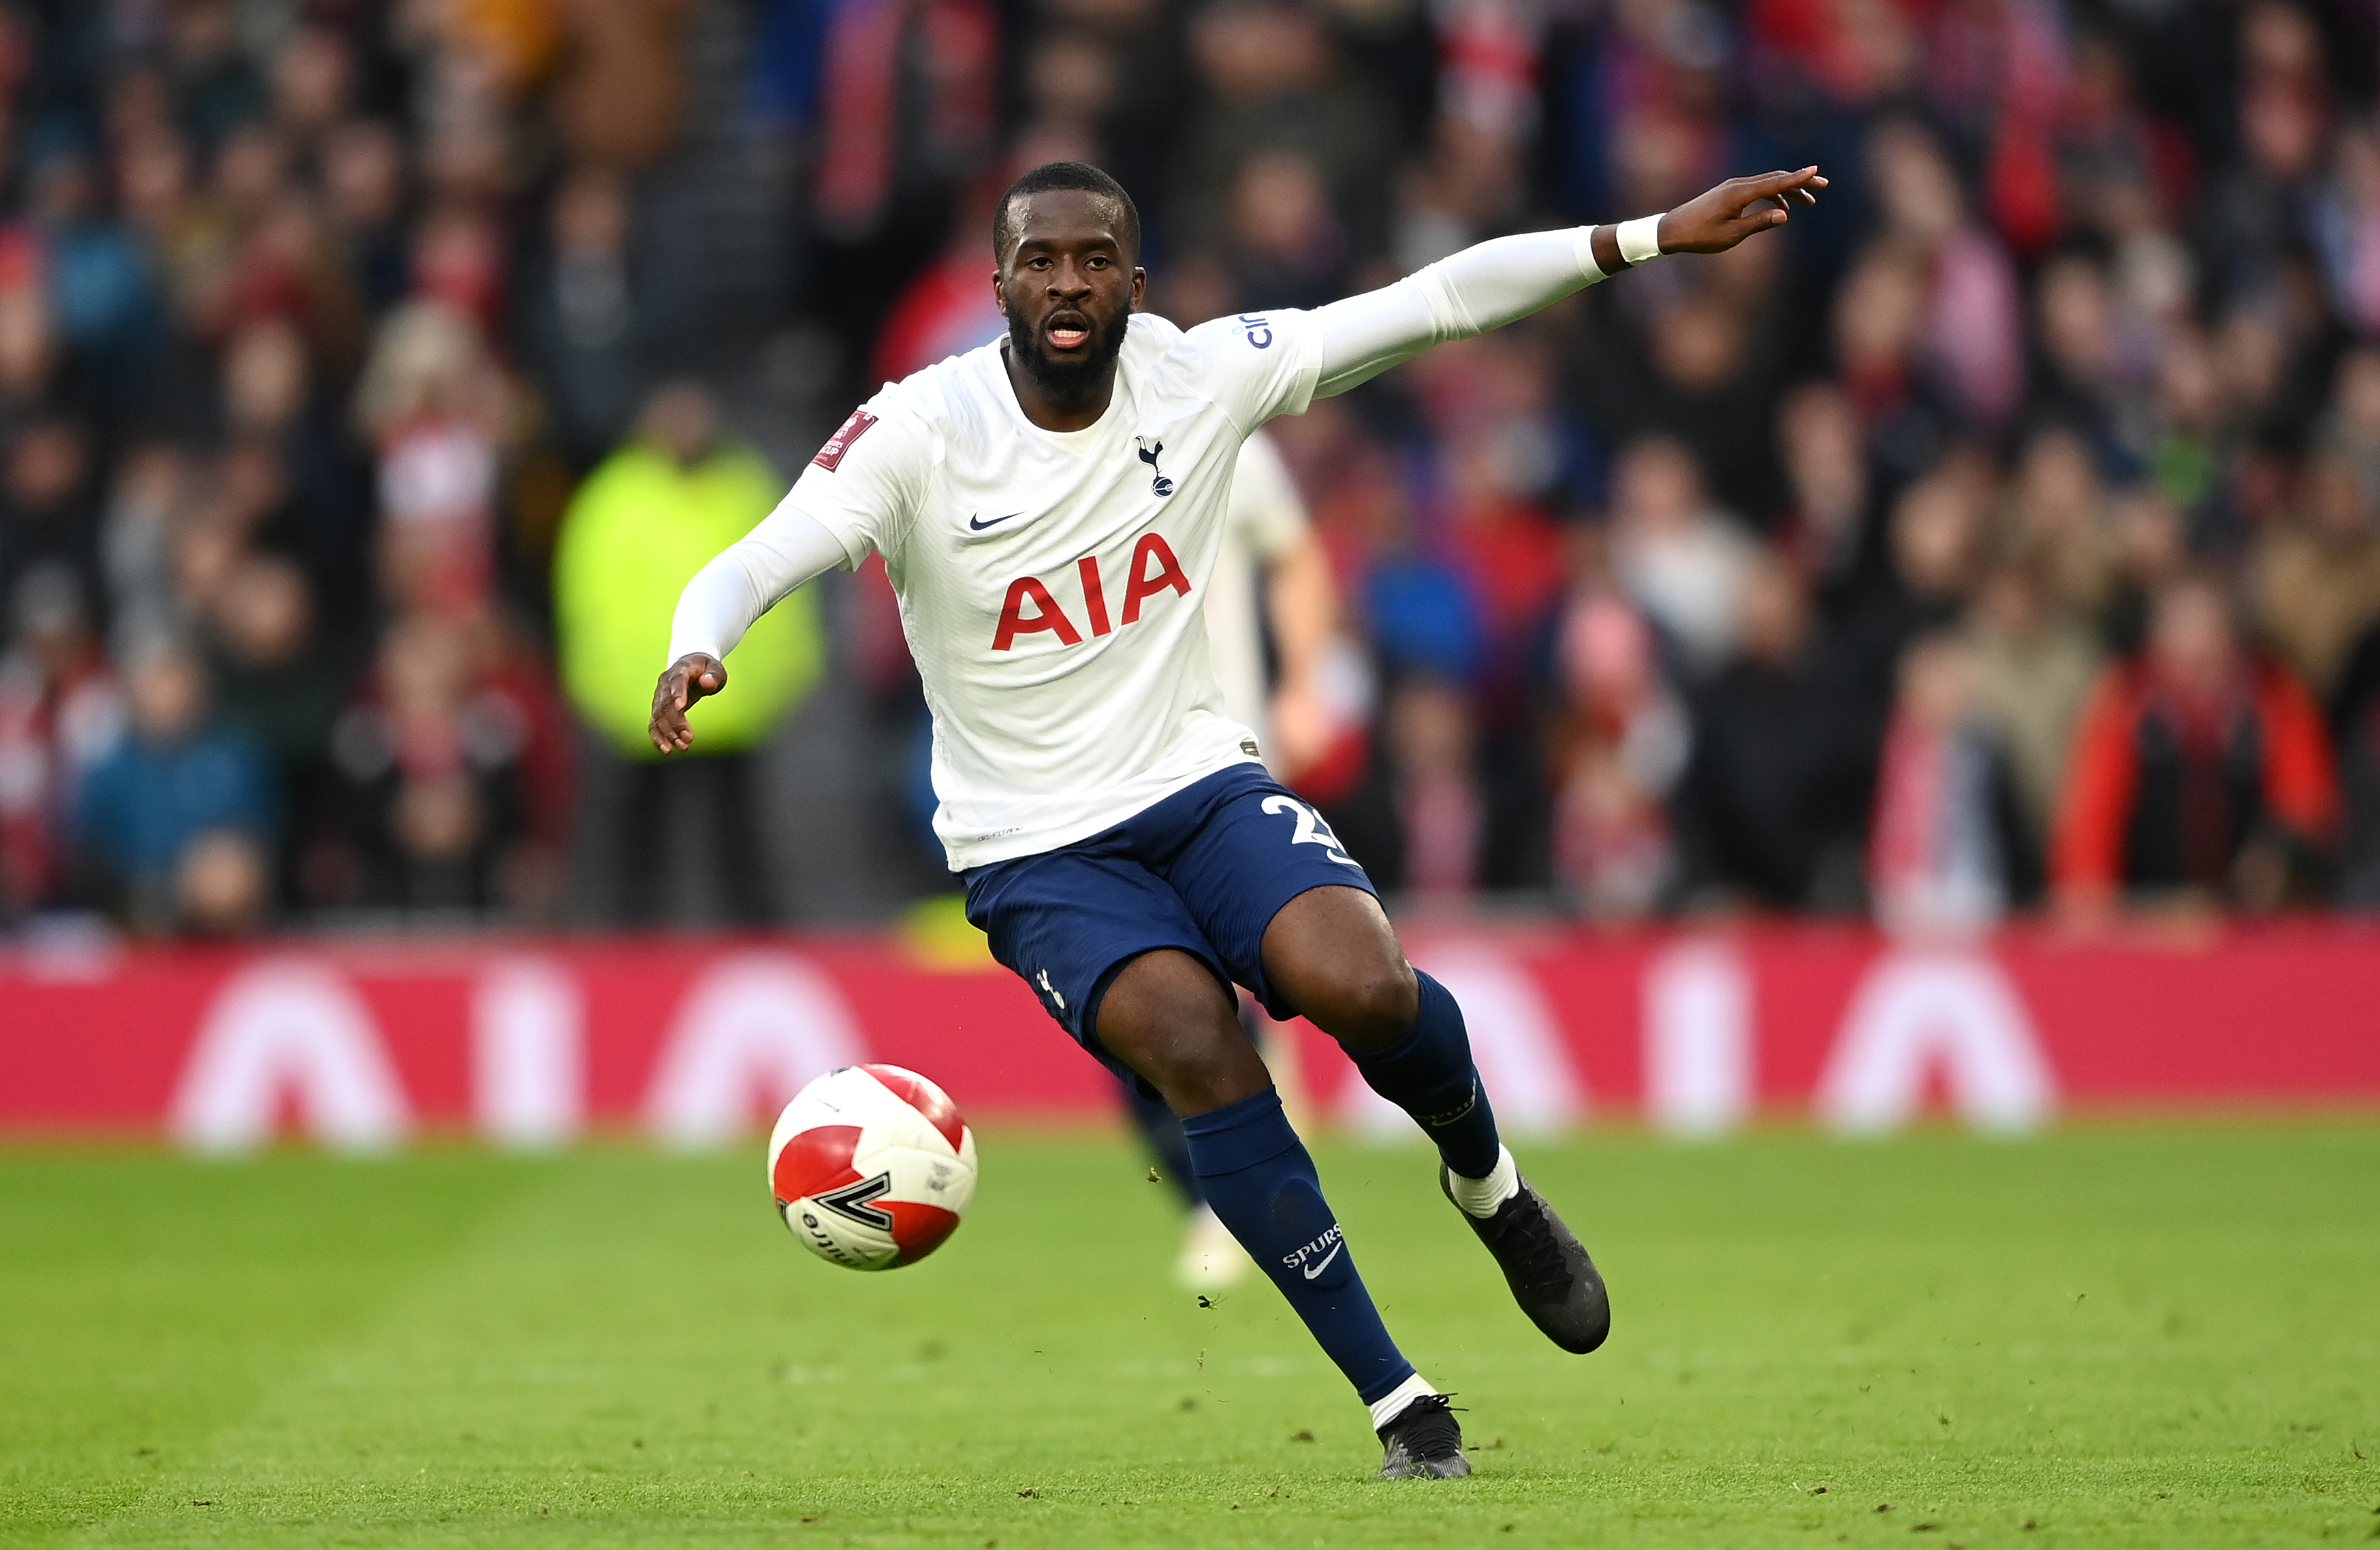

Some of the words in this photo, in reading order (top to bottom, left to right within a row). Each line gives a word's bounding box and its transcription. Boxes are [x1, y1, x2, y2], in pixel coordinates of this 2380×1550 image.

[991, 533, 1192, 651] AIA
[170, 951, 875, 1158] AIA
[1283, 1223, 1343, 1269] SPURS
